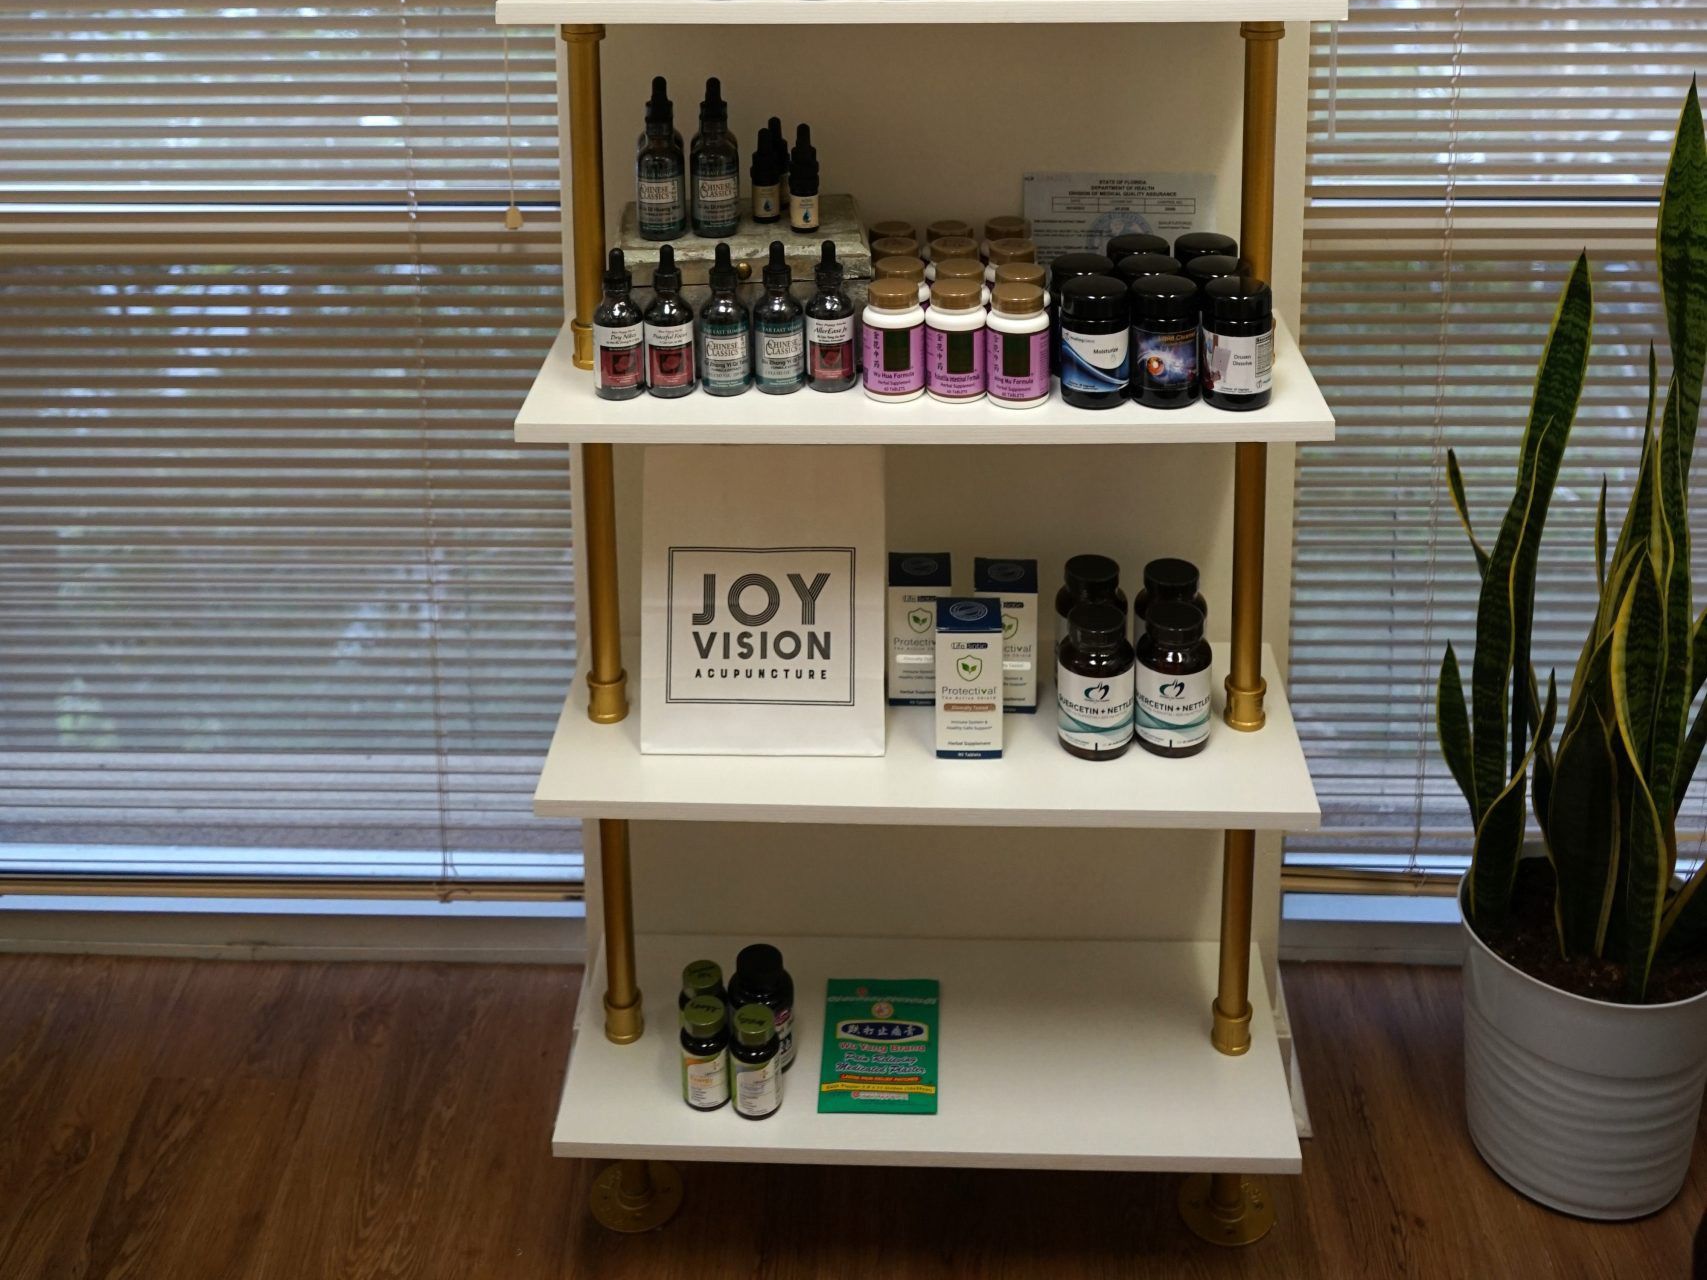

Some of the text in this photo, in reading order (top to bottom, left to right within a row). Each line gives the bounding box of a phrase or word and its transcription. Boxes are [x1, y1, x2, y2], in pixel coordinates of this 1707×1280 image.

[707, 340, 737, 350] CHINESE
[766, 340, 798, 349] CHINESE
[707, 348, 738, 356] CLASSICS
[766, 347, 798, 355] CLASSICS
[692, 573, 831, 627] JOY
[692, 631, 831, 660] VISION
[695, 669, 827, 679] ACUPUNCTURE
[836, 1064, 887, 1073] Medicated
